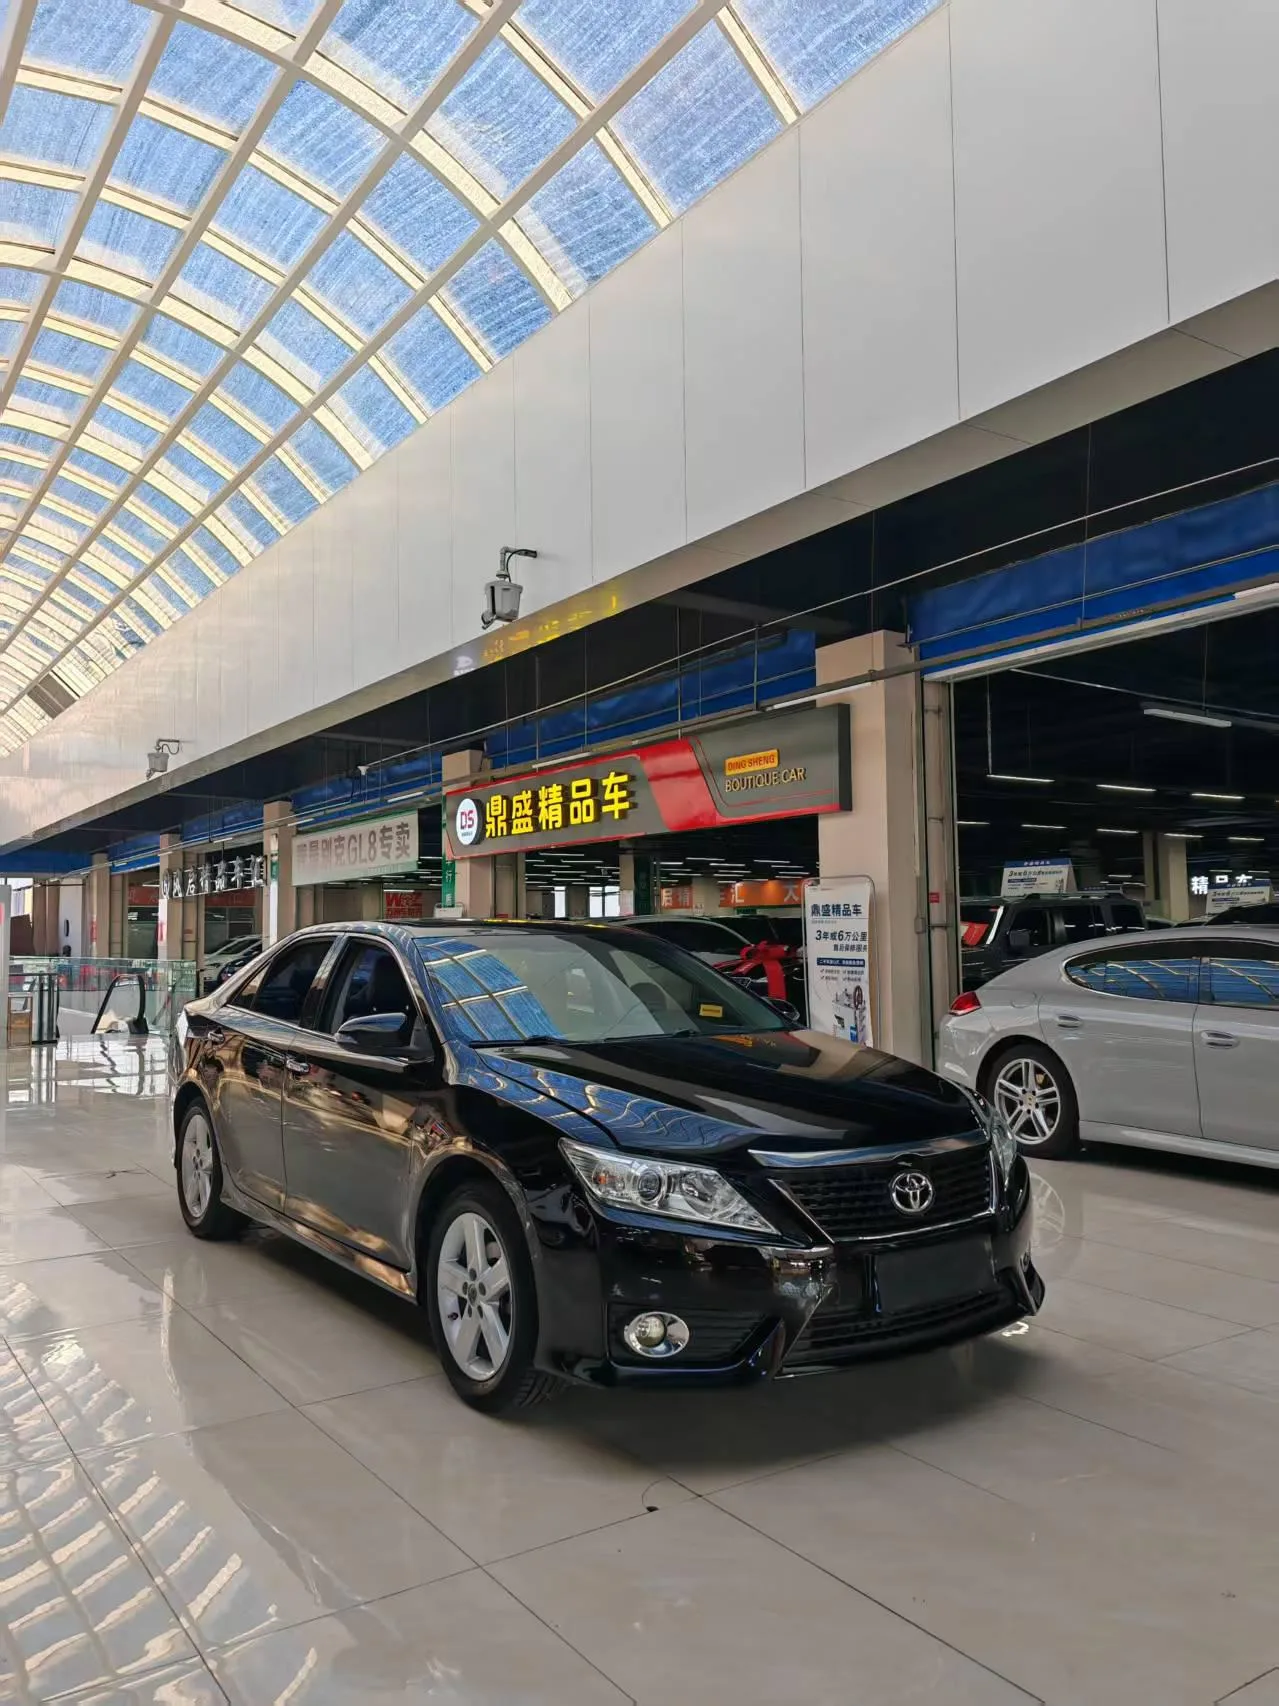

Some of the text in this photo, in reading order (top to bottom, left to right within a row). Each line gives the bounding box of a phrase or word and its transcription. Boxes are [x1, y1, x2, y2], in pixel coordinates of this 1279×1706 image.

[727, 754, 775, 771] DING SHENG
[725, 767, 805, 792] BOUTIQUE CAR
[486, 772, 630, 838] 鼎盛精品车
[460, 810, 475, 829] DS
[811, 903, 862, 917] 鼎盛精品车
